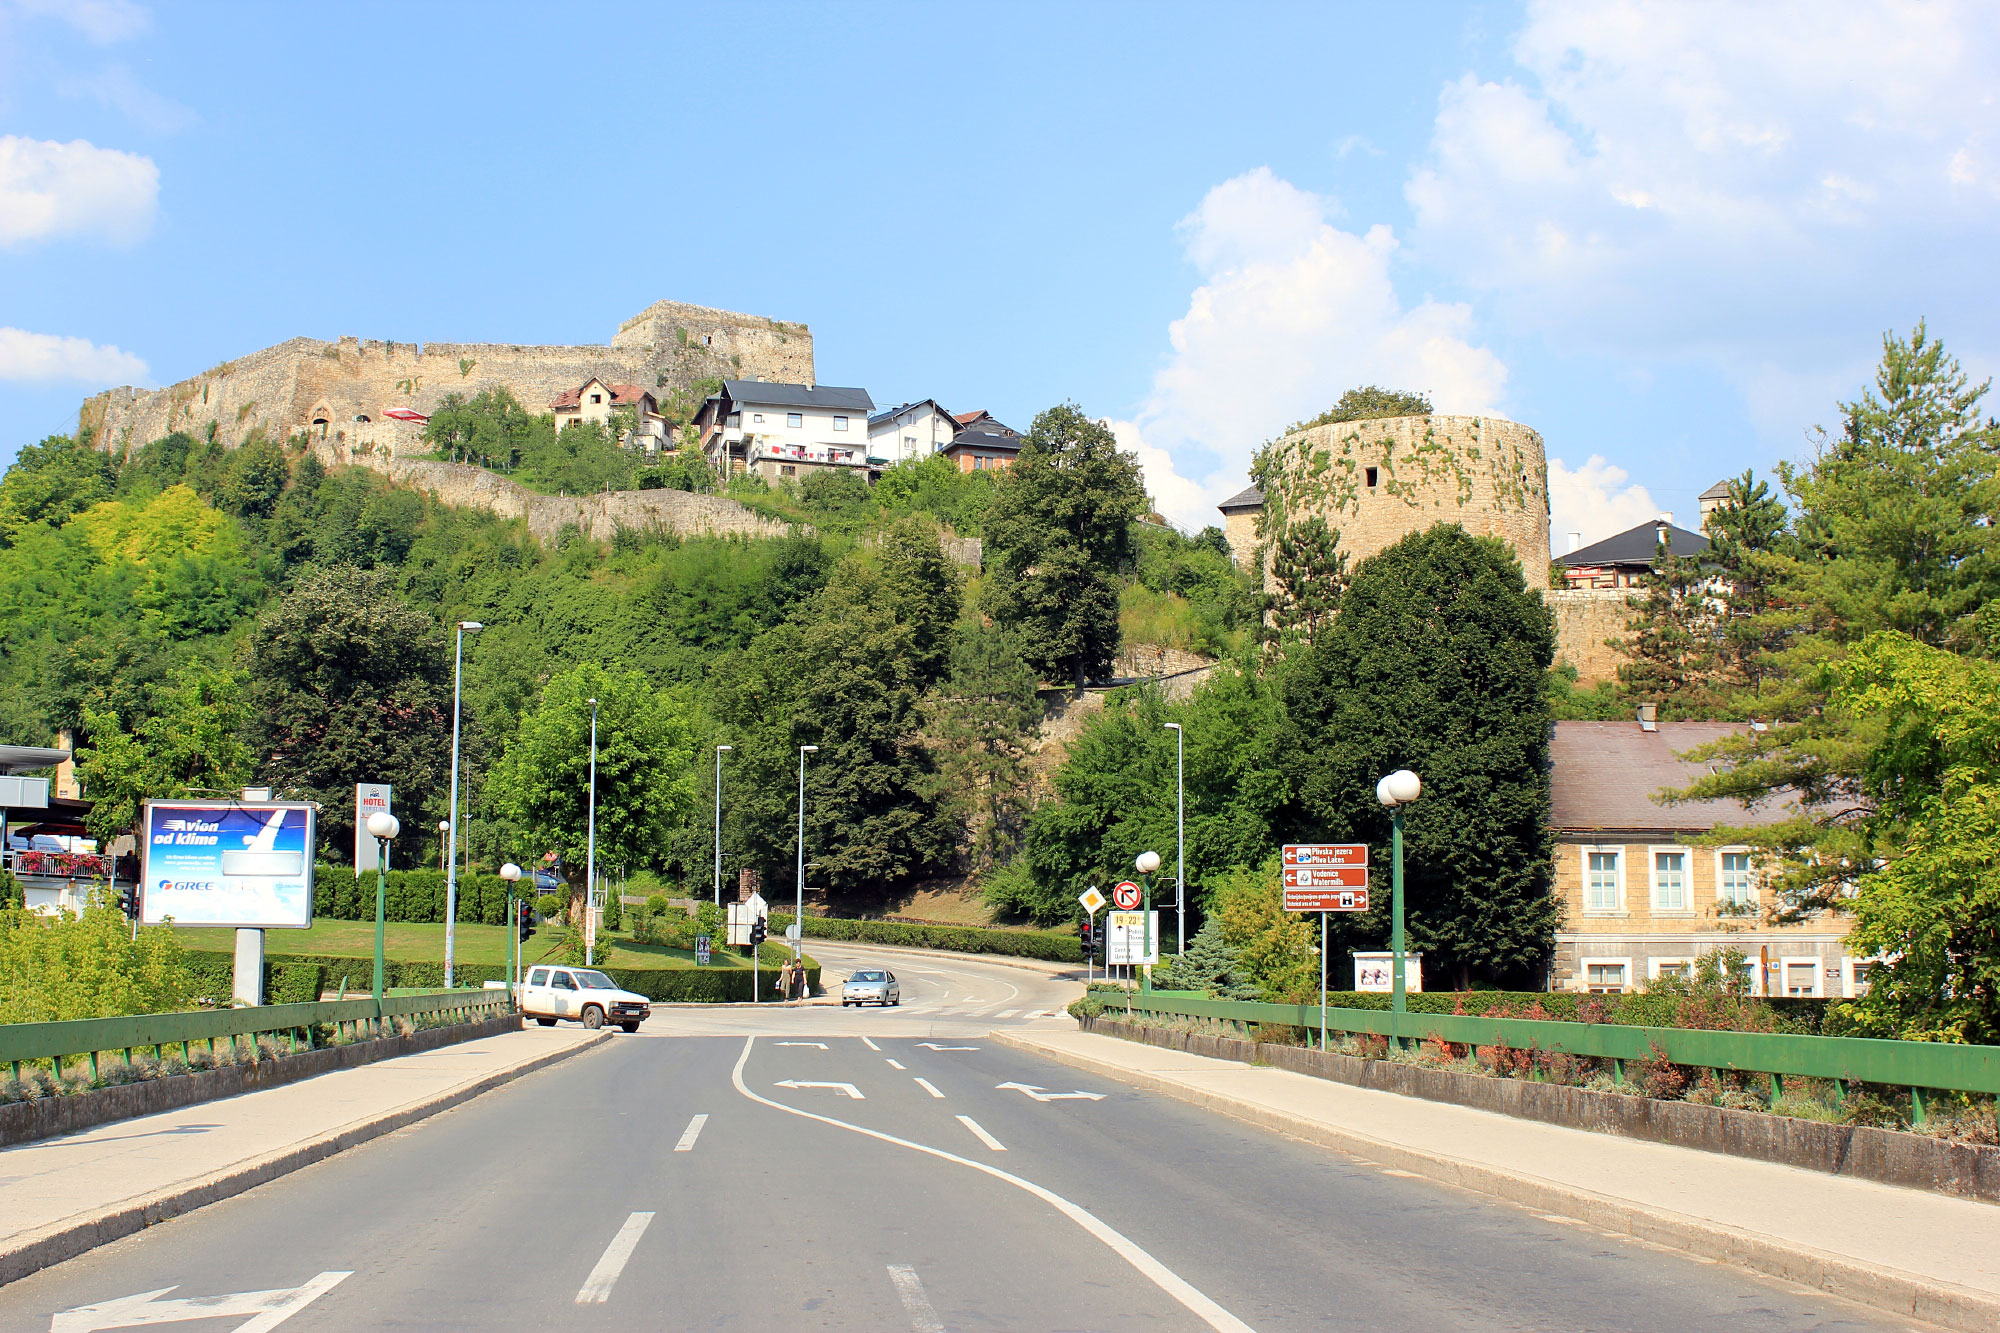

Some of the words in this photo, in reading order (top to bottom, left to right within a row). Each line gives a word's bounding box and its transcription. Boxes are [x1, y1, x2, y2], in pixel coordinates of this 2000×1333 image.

[363, 798, 386, 806] HOTEL
[164, 819, 219, 832] Avion
[154, 833, 173, 845] od
[175, 833, 218, 845] klime
[1334, 848, 1352, 857] jezera
[1312, 856, 1327, 864] Pliva
[1327, 856, 1345, 864] Lakes
[175, 881, 214, 891] GREE
[1312, 878, 1344, 886] Watermills
[1116, 916, 1123, 924] 19
